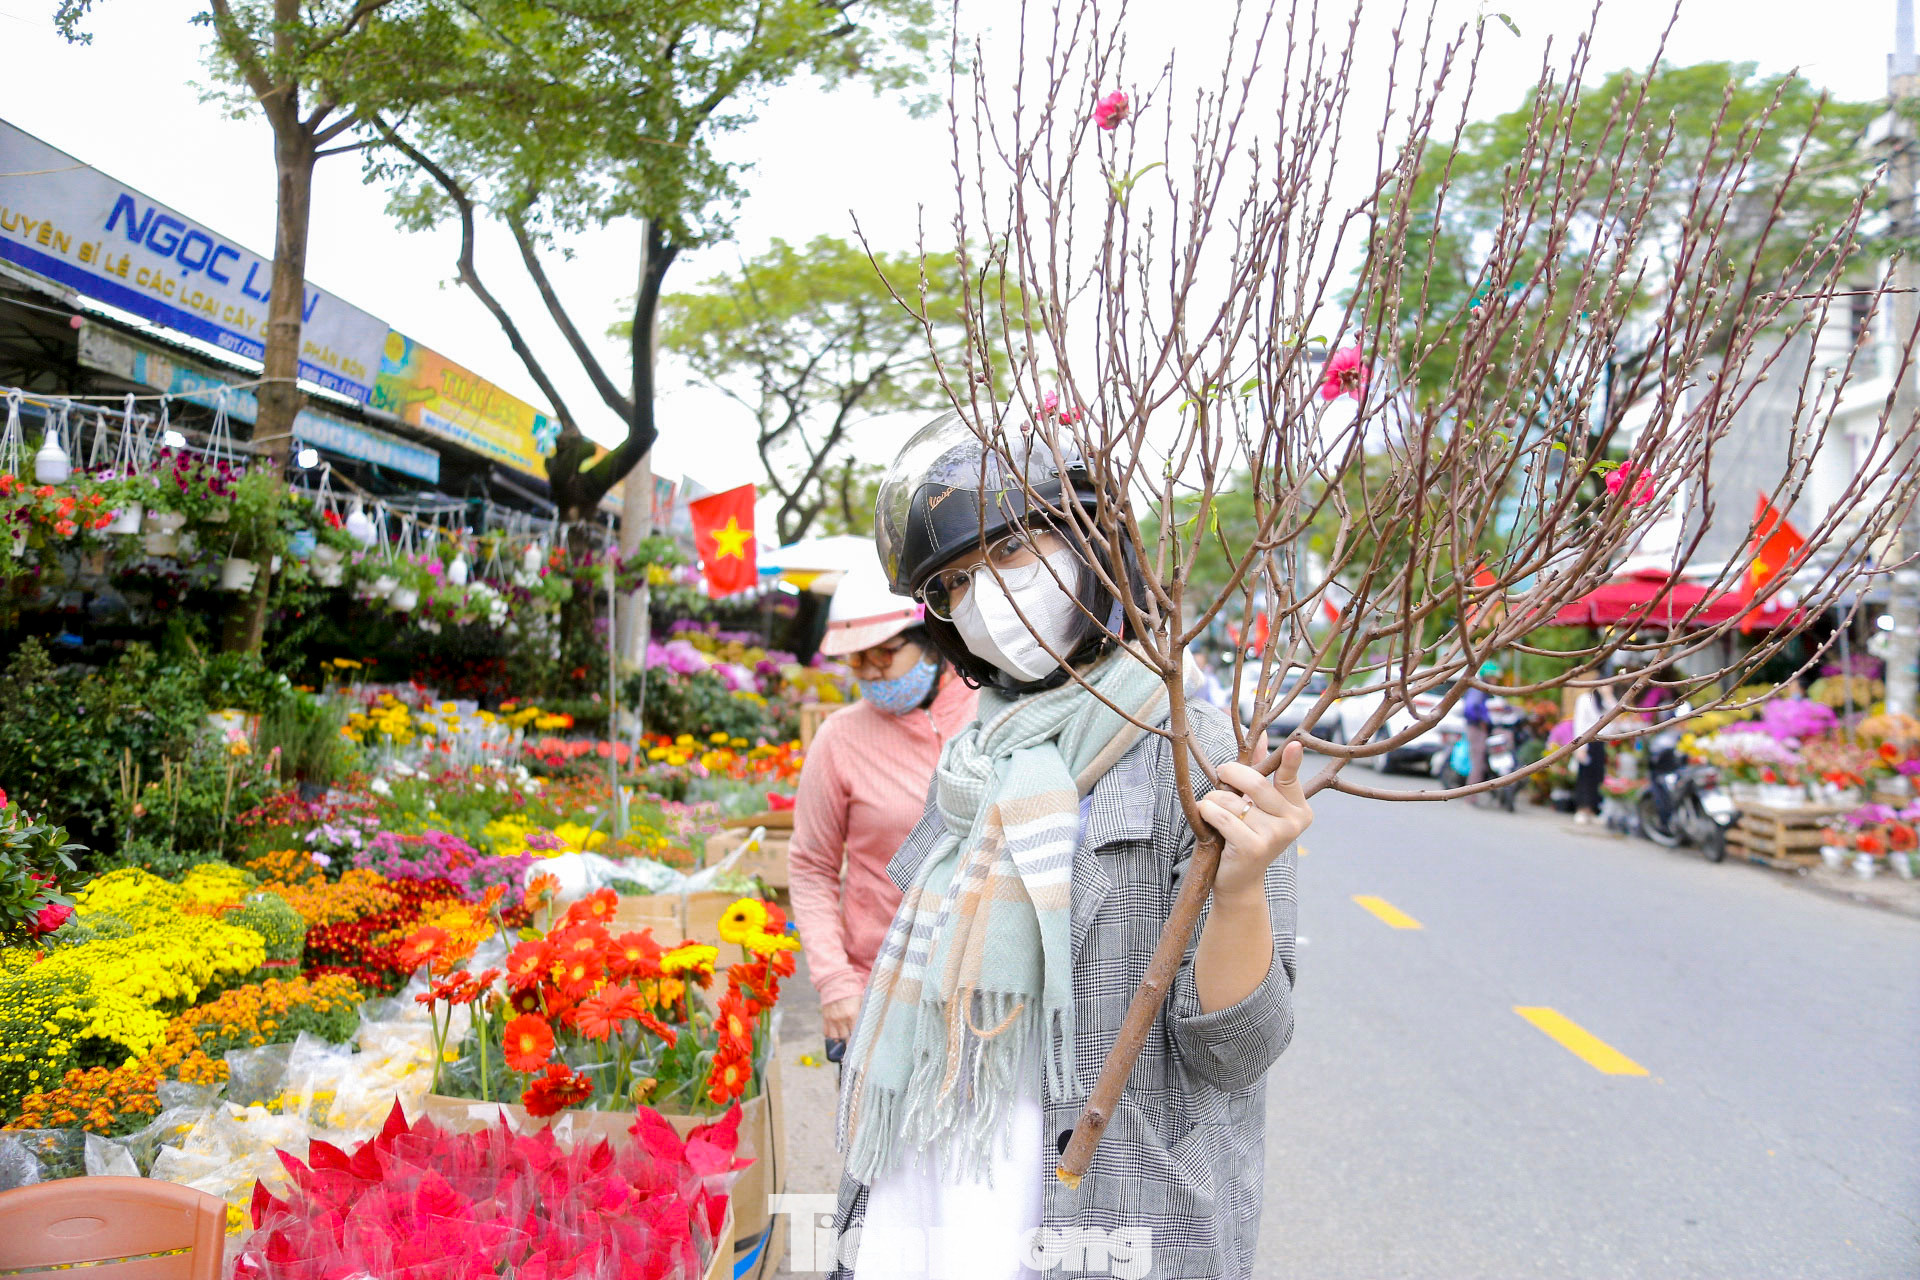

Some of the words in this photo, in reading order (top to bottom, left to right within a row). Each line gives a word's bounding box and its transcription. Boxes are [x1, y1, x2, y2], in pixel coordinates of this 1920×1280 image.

[0, 203, 72, 253] UYÊN
[136, 267, 175, 297] CÁC
[180, 285, 219, 317] LOẠI
[223, 305, 256, 330] CÂY
[104, 193, 240, 285] NGỌC
[241, 261, 320, 323] LN
